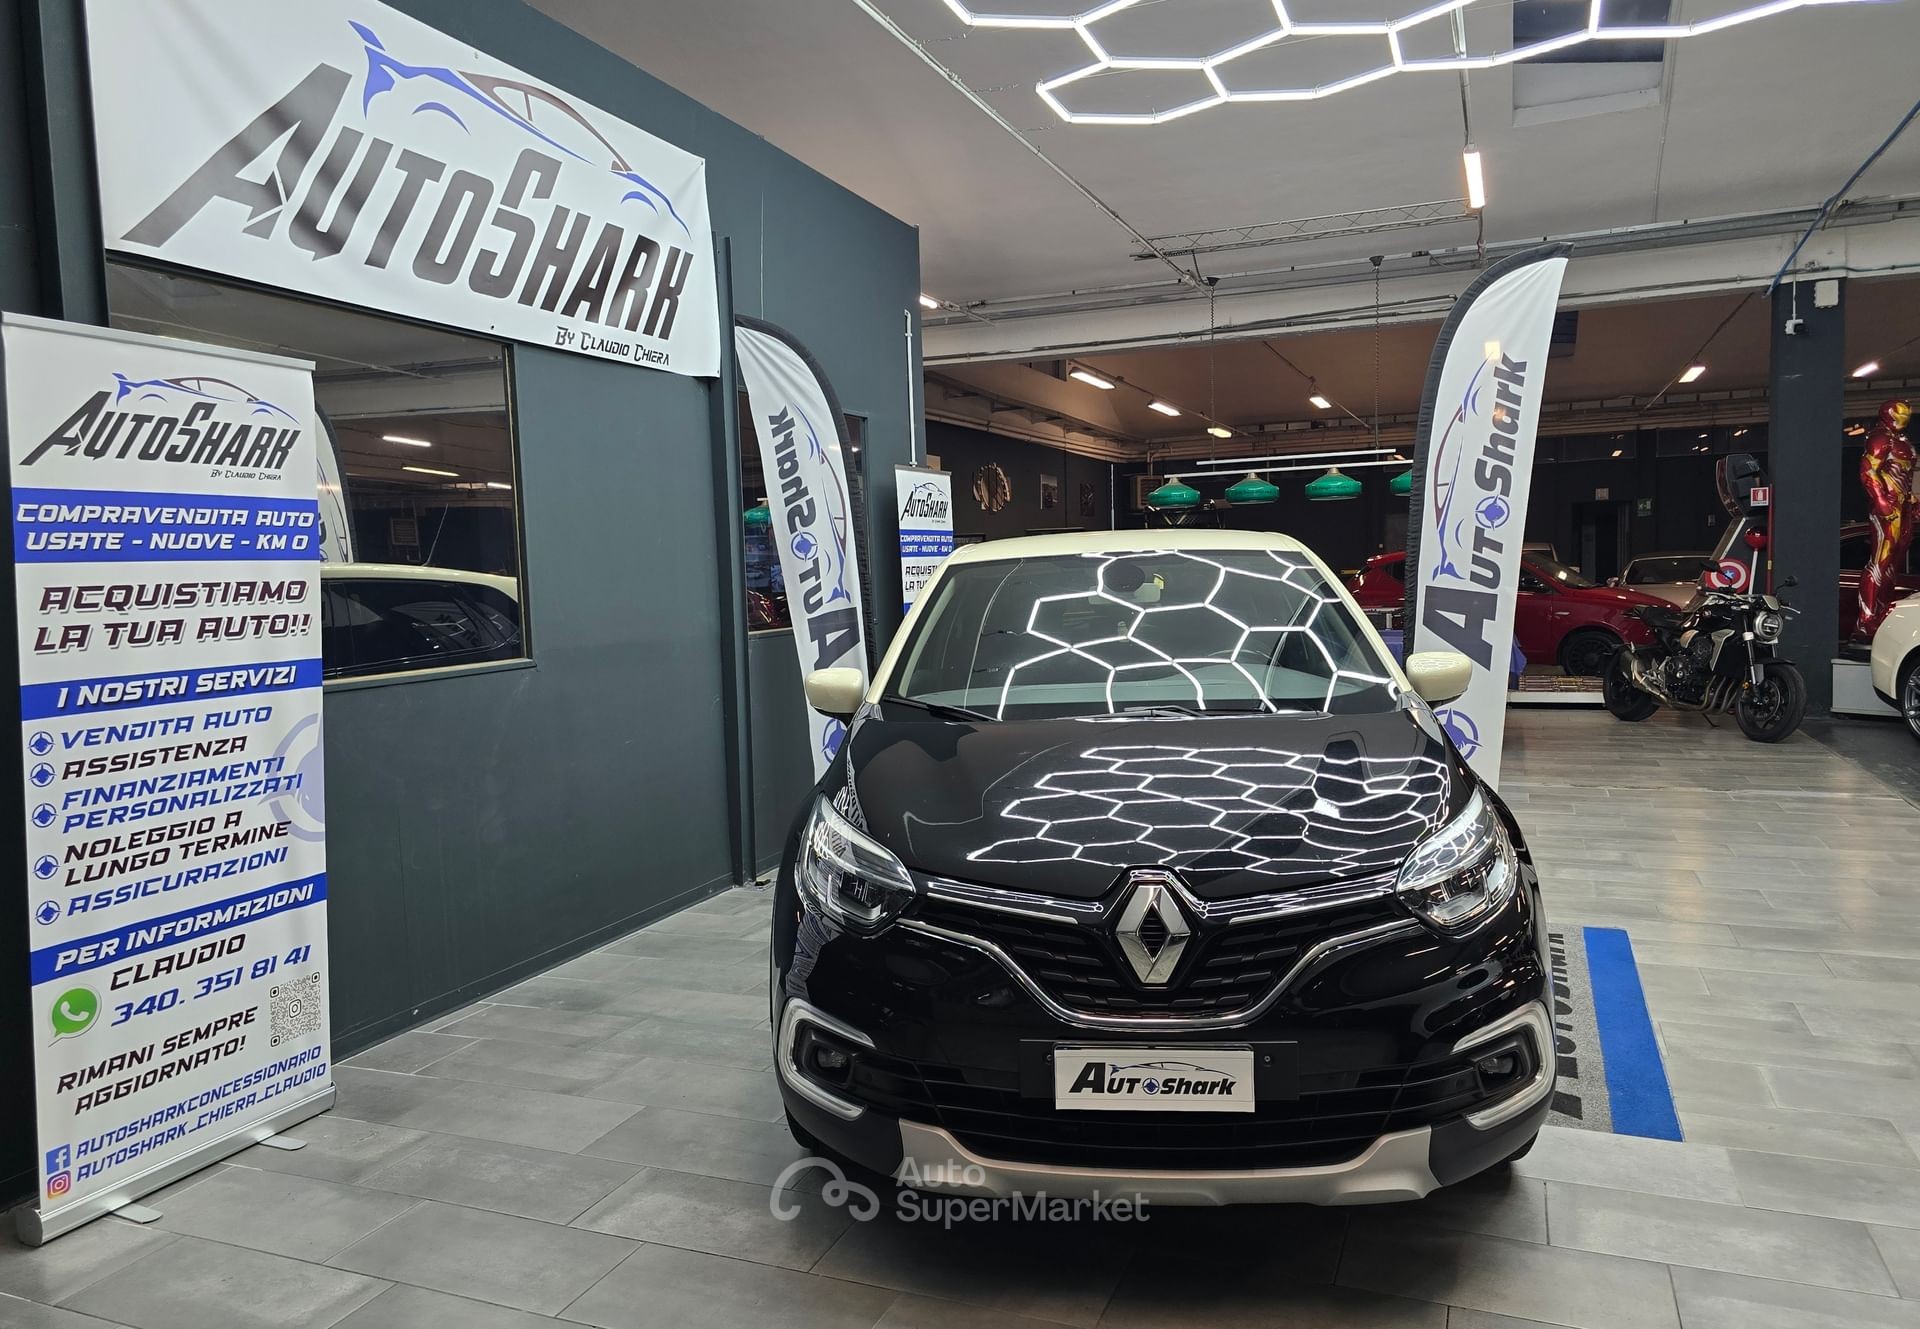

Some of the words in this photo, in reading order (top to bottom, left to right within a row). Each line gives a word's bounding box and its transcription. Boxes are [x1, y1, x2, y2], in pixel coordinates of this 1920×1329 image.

[17, 504, 249, 526] COMPRAVENDITA
[256, 510, 315, 528] AUTO
[26, 532, 123, 550] USATE
[150, 534, 235, 551] NUOVE
[256, 534, 287, 551] KM
[901, 535, 939, 543] COMPRAVENDITA
[941, 535, 953, 543] AUTO
[39, 580, 308, 613] ACQUISTIAMO
[905, 566, 937, 575] ACQUIST
[905, 581, 915, 590] LA
[33, 624, 93, 653] LA
[103, 618, 185, 647] TUA
[197, 613, 312, 641] AUTO!!
[57, 686, 68, 708] I
[76, 683, 188, 706] NOSTRI
[195, 665, 297, 693] SERVIZI
[60, 715, 193, 749] VENDITA
[202, 706, 273, 730] AUTO
[62, 735, 248, 780] ASSISTENZA
[62, 756, 286, 811] FINANZIAMENTI
[62, 773, 304, 834] PERSONALIZZATI
[63, 816, 216, 863] NOLEGGIO
[223, 810, 243, 830] A
[64, 846, 170, 887] LUNGO
[180, 820, 292, 860] TERMINE
[67, 846, 289, 916] ASSICURAZIONI
[54, 937, 121, 973] PER
[126, 883, 314, 952] INFORMAZIONI
[110, 933, 247, 991] CLAUDIO
[111, 987, 186, 1027] 340.
[193, 967, 243, 999] 351
[250, 955, 276, 979] 81
[283, 944, 312, 966] 41
[56, 1043, 153, 1094] RIMANI
[160, 1006, 259, 1056] SEMPRE
[74, 1035, 247, 1116] AGGIORNATO!
[75, 1045, 322, 1159] AUTOSHARKCONCESSIONARIO
[76, 1063, 327, 1182] AUTOSHARK_CHIERA_CLAUDIO
